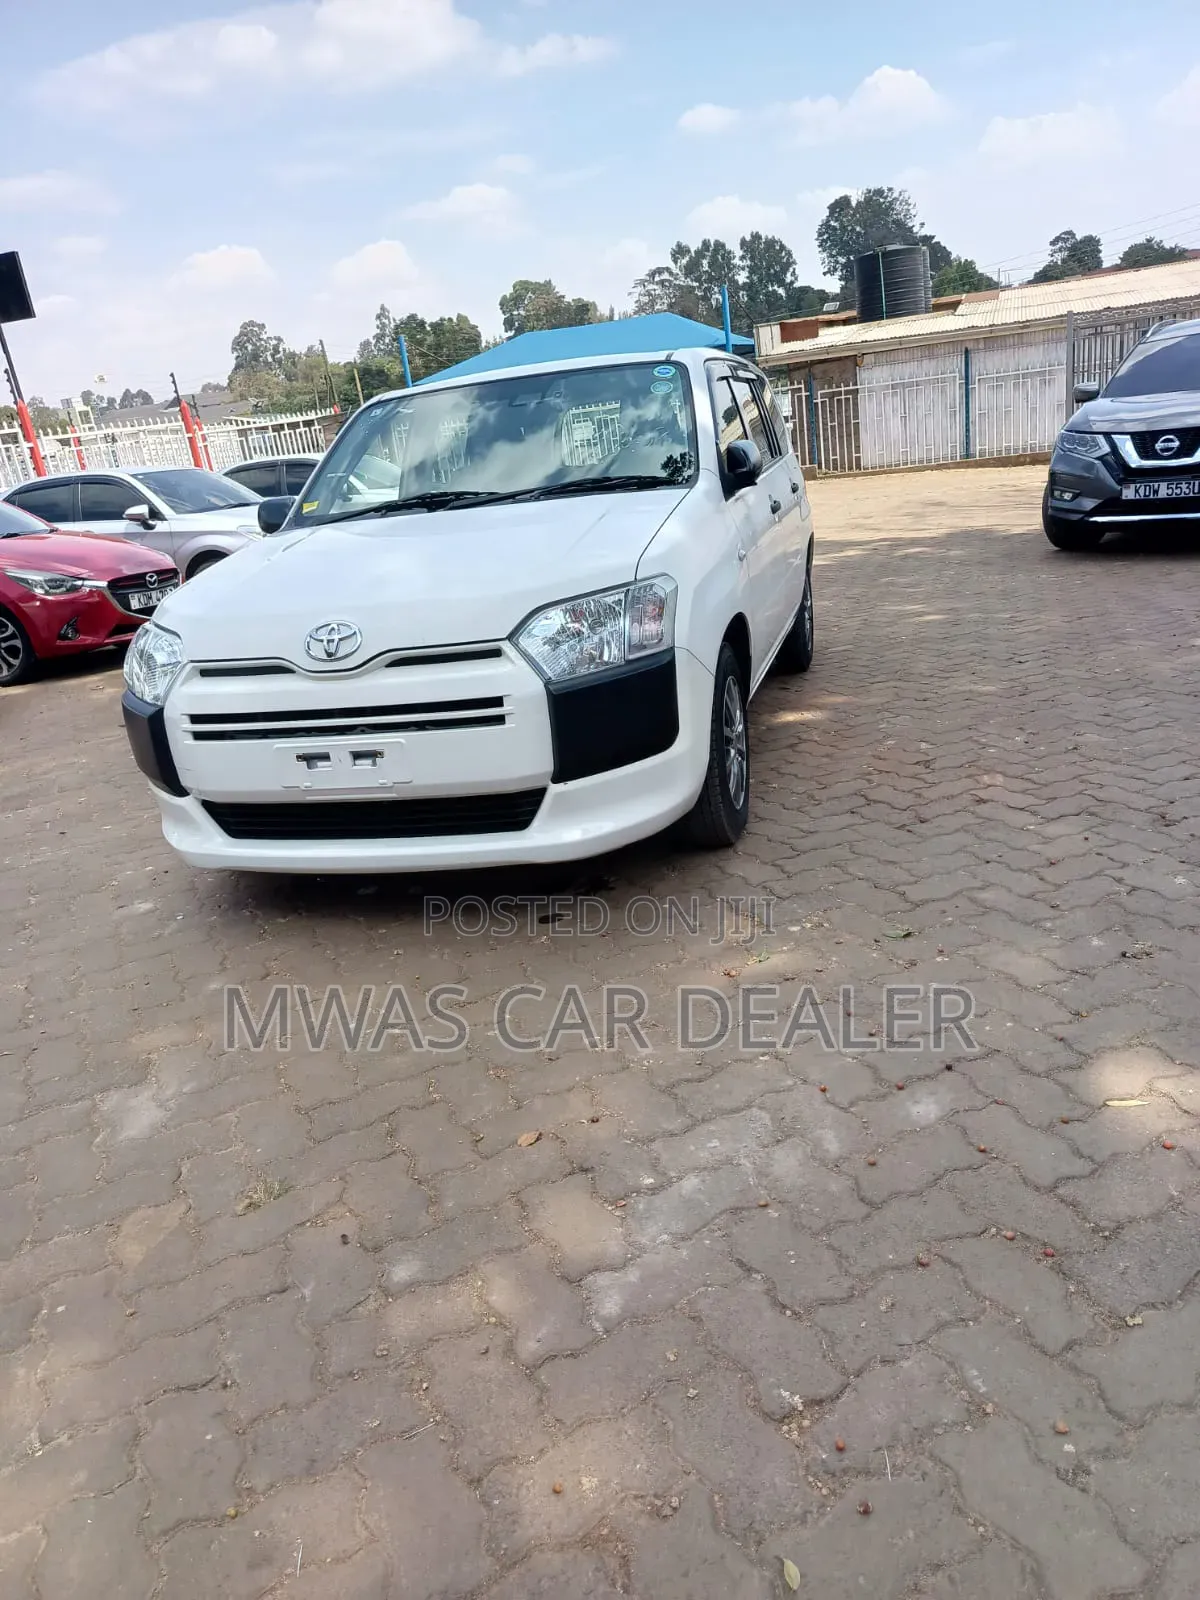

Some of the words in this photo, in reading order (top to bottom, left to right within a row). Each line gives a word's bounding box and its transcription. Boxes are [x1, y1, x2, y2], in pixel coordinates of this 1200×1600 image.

[1134, 483, 1160, 498] KDW
[1166, 481, 1200, 497] 553U
[137, 592, 154, 607] KDM
